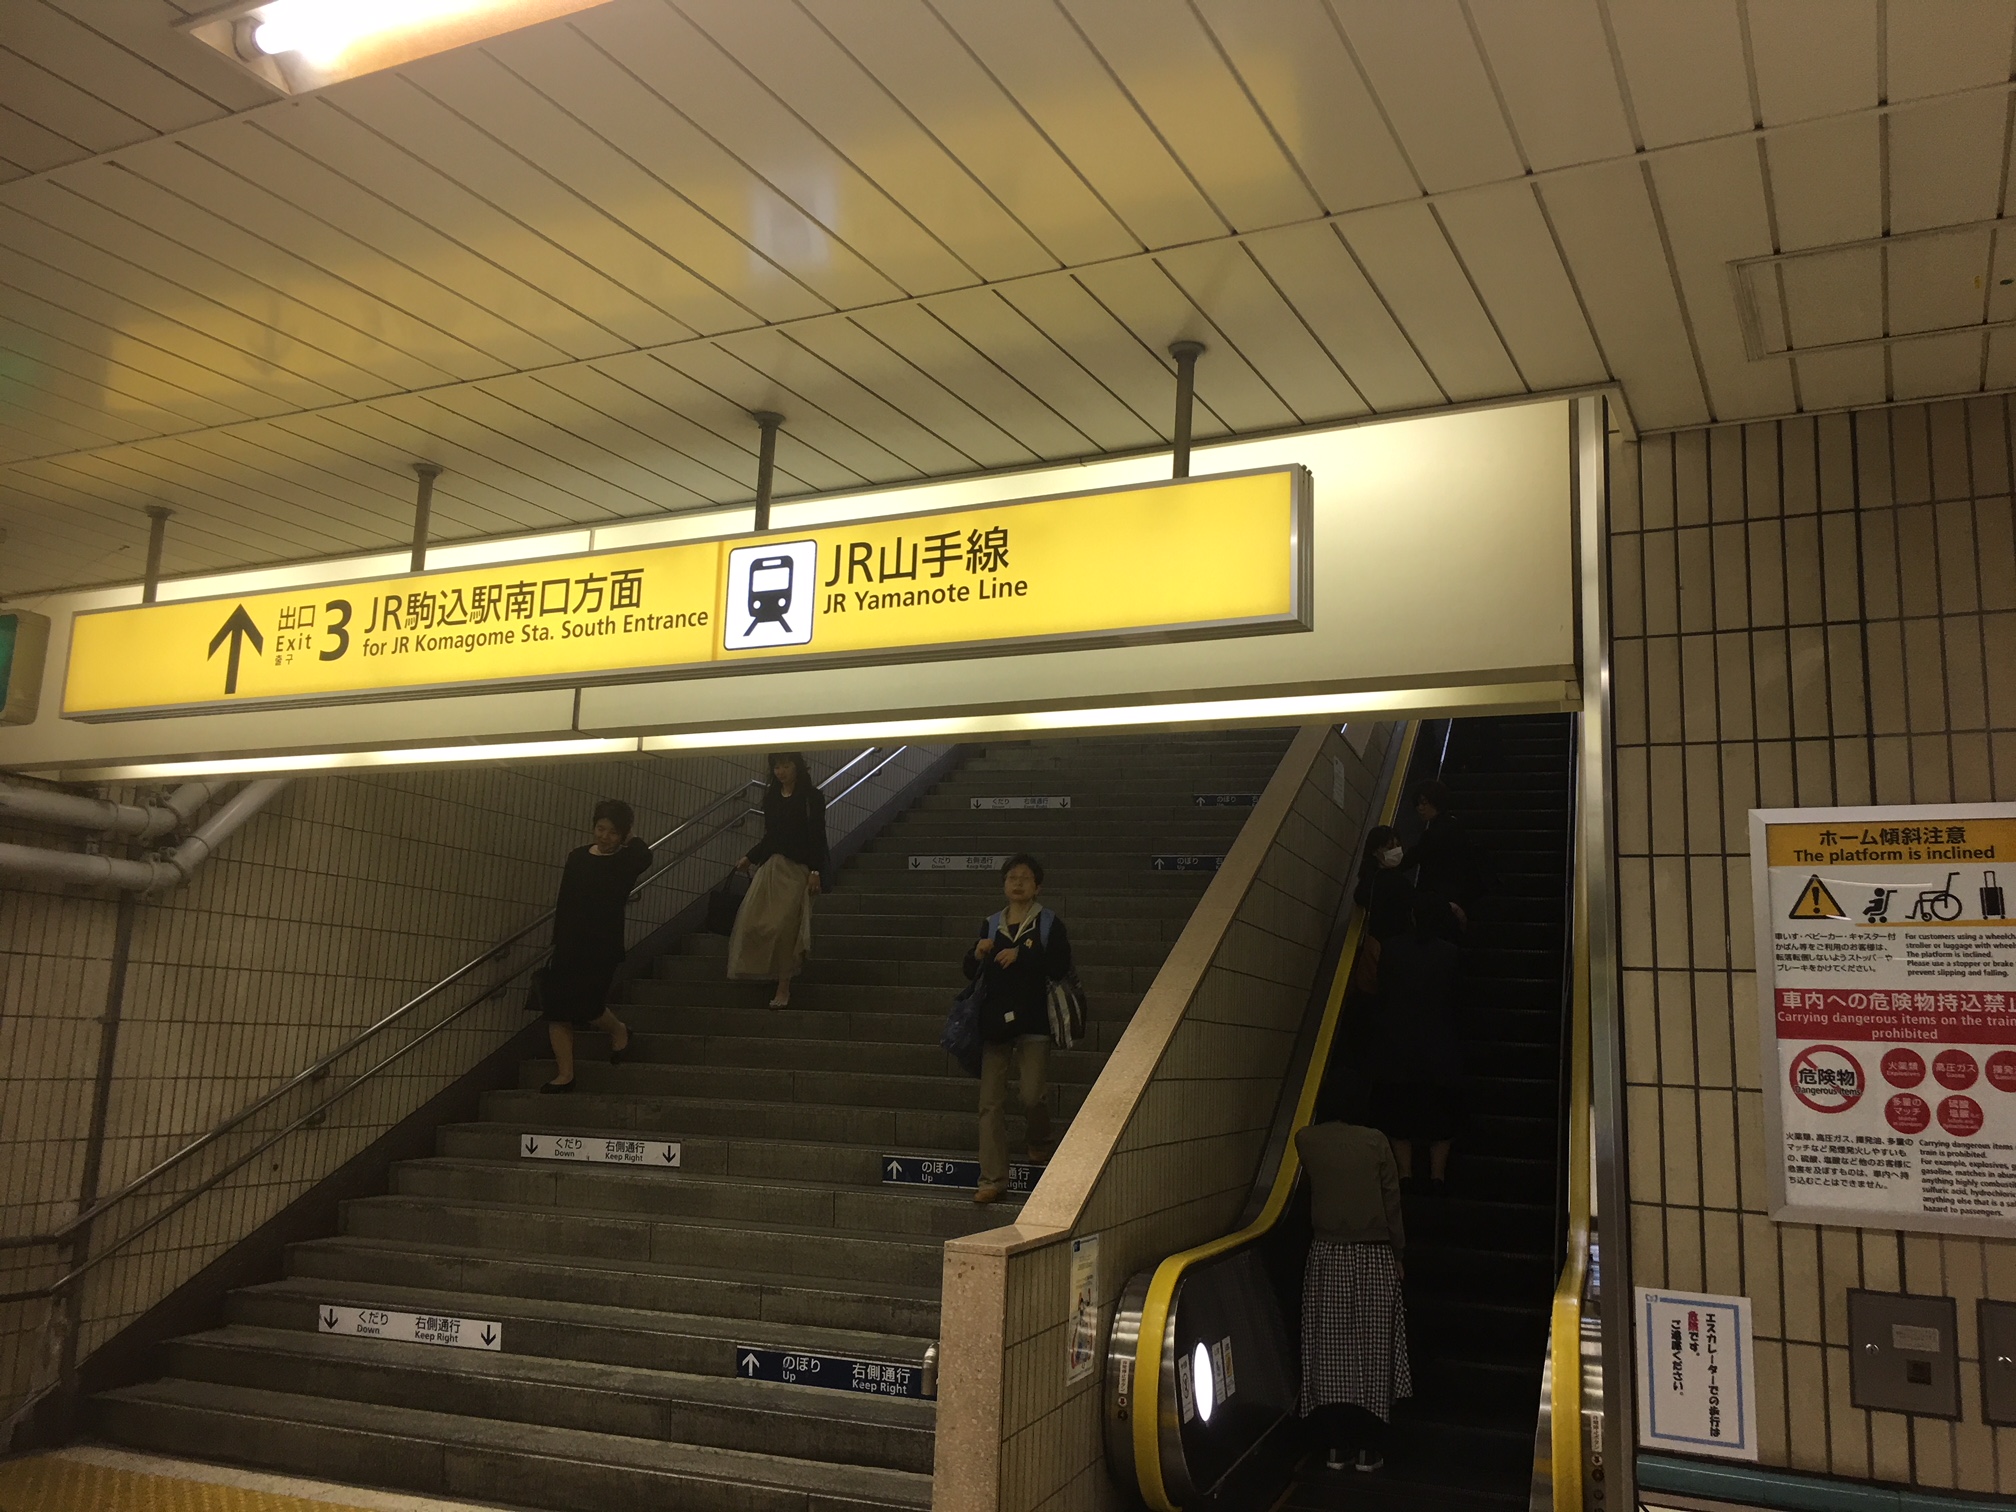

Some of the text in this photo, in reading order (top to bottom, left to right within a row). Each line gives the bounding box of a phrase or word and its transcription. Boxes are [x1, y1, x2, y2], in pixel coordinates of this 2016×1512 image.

[825, 526, 1009, 587] JR山手線
[364, 568, 644, 633] JR駒込駅南口方面
[823, 577, 1028, 614] JR Yamanote Line
[278, 604, 316, 631] 出口
[318, 599, 353, 662] 3
[363, 610, 709, 657] for JR Komagome Sta. South Entrance
[275, 633, 312, 652] Exit
[1819, 826, 1966, 846] ホーム傾斜注意
[1793, 845, 1995, 864] The platform is inclined
[1943, 942, 1973, 950] luggage
[1957, 933, 1977, 941] using
[1985, 932, 2016, 940] wheelch
[1907, 969, 1935, 977] prevent
[1937, 969, 1966, 977] slipping
[1952, 960, 1981, 968] stopper
[1777, 1011, 2016, 1027] Carrying dangerous items on the train
[1871, 1028, 1938, 1040] prohibited
[1798, 1067, 1855, 1086] 危険物
[1794, 1085, 1837, 1096] Dangerous
[1893, 1107, 1921, 1116] マッチ
[555, 1138, 645, 1154] くだり 右側通行
[1919, 1139, 2013, 1151] Carrying dangerous items
[554, 1149, 643, 1163] Down Keep Right
[921, 1161, 1030, 1181] のぼり 通行
[921, 1173, 1027, 1189] Up ight
[1921, 1178, 1954, 1187] anything
[1922, 1196, 1955, 1205] anything
[1923, 1204, 1948, 1212] hazard
[359, 1310, 461, 1334] くだり 右側通行
[356, 1324, 458, 1344] Down Keep Right
[782, 1356, 911, 1385] のぼり 右側通行
[1705, 1313, 1720, 1437] エスカレーターでの歩行は
[782, 1370, 907, 1396] Up Keep Right
